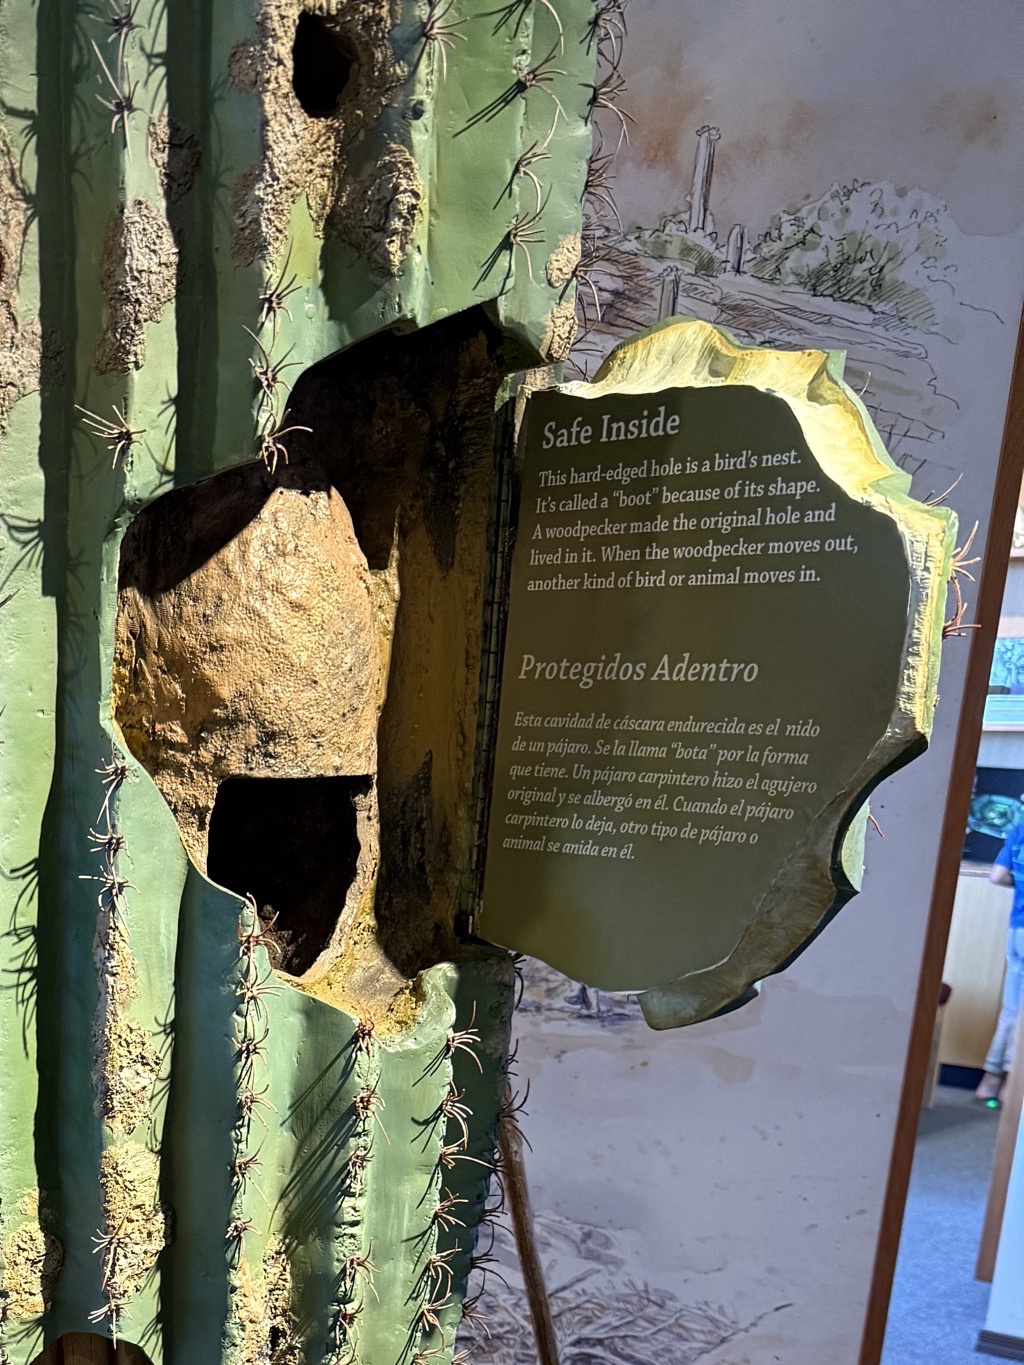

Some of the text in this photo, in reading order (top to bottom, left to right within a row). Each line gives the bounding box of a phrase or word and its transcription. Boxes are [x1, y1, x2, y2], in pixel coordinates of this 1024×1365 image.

[542, 405, 680, 449] Safe Inside
[538, 469, 567, 487] This
[569, 459, 648, 485] hard-edged
[650, 457, 682, 477] hole
[685, 457, 699, 474] is
[701, 460, 711, 472] a
[761, 449, 801, 467] nest.
[559, 492, 598, 512] called
[600, 497, 609, 508] a
[662, 486, 721, 504] because
[724, 480, 743, 499] of
[743, 480, 765, 498] its
[768, 476, 820, 500] shape.
[532, 502, 836, 542] A woodpecker made the original hole and
[529, 535, 858, 565] lived in it. When the woodpecker moves out,
[518, 652, 759, 689] Protegidos Adentro
[513, 711, 820, 737] Esta cavidad de cáscara endurecida es el nido
[511, 735, 527, 751] de
[528, 741, 545, 752] un
[546, 738, 591, 758] pájaro.
[594, 739, 611, 755] Se
[612, 739, 626, 756] la
[628, 740, 668, 758] llama
[716, 749, 745, 766] por
[746, 745, 760, 763] la
[761, 746, 809, 767] forma
[502, 835, 635, 859] animal se anida en él.
